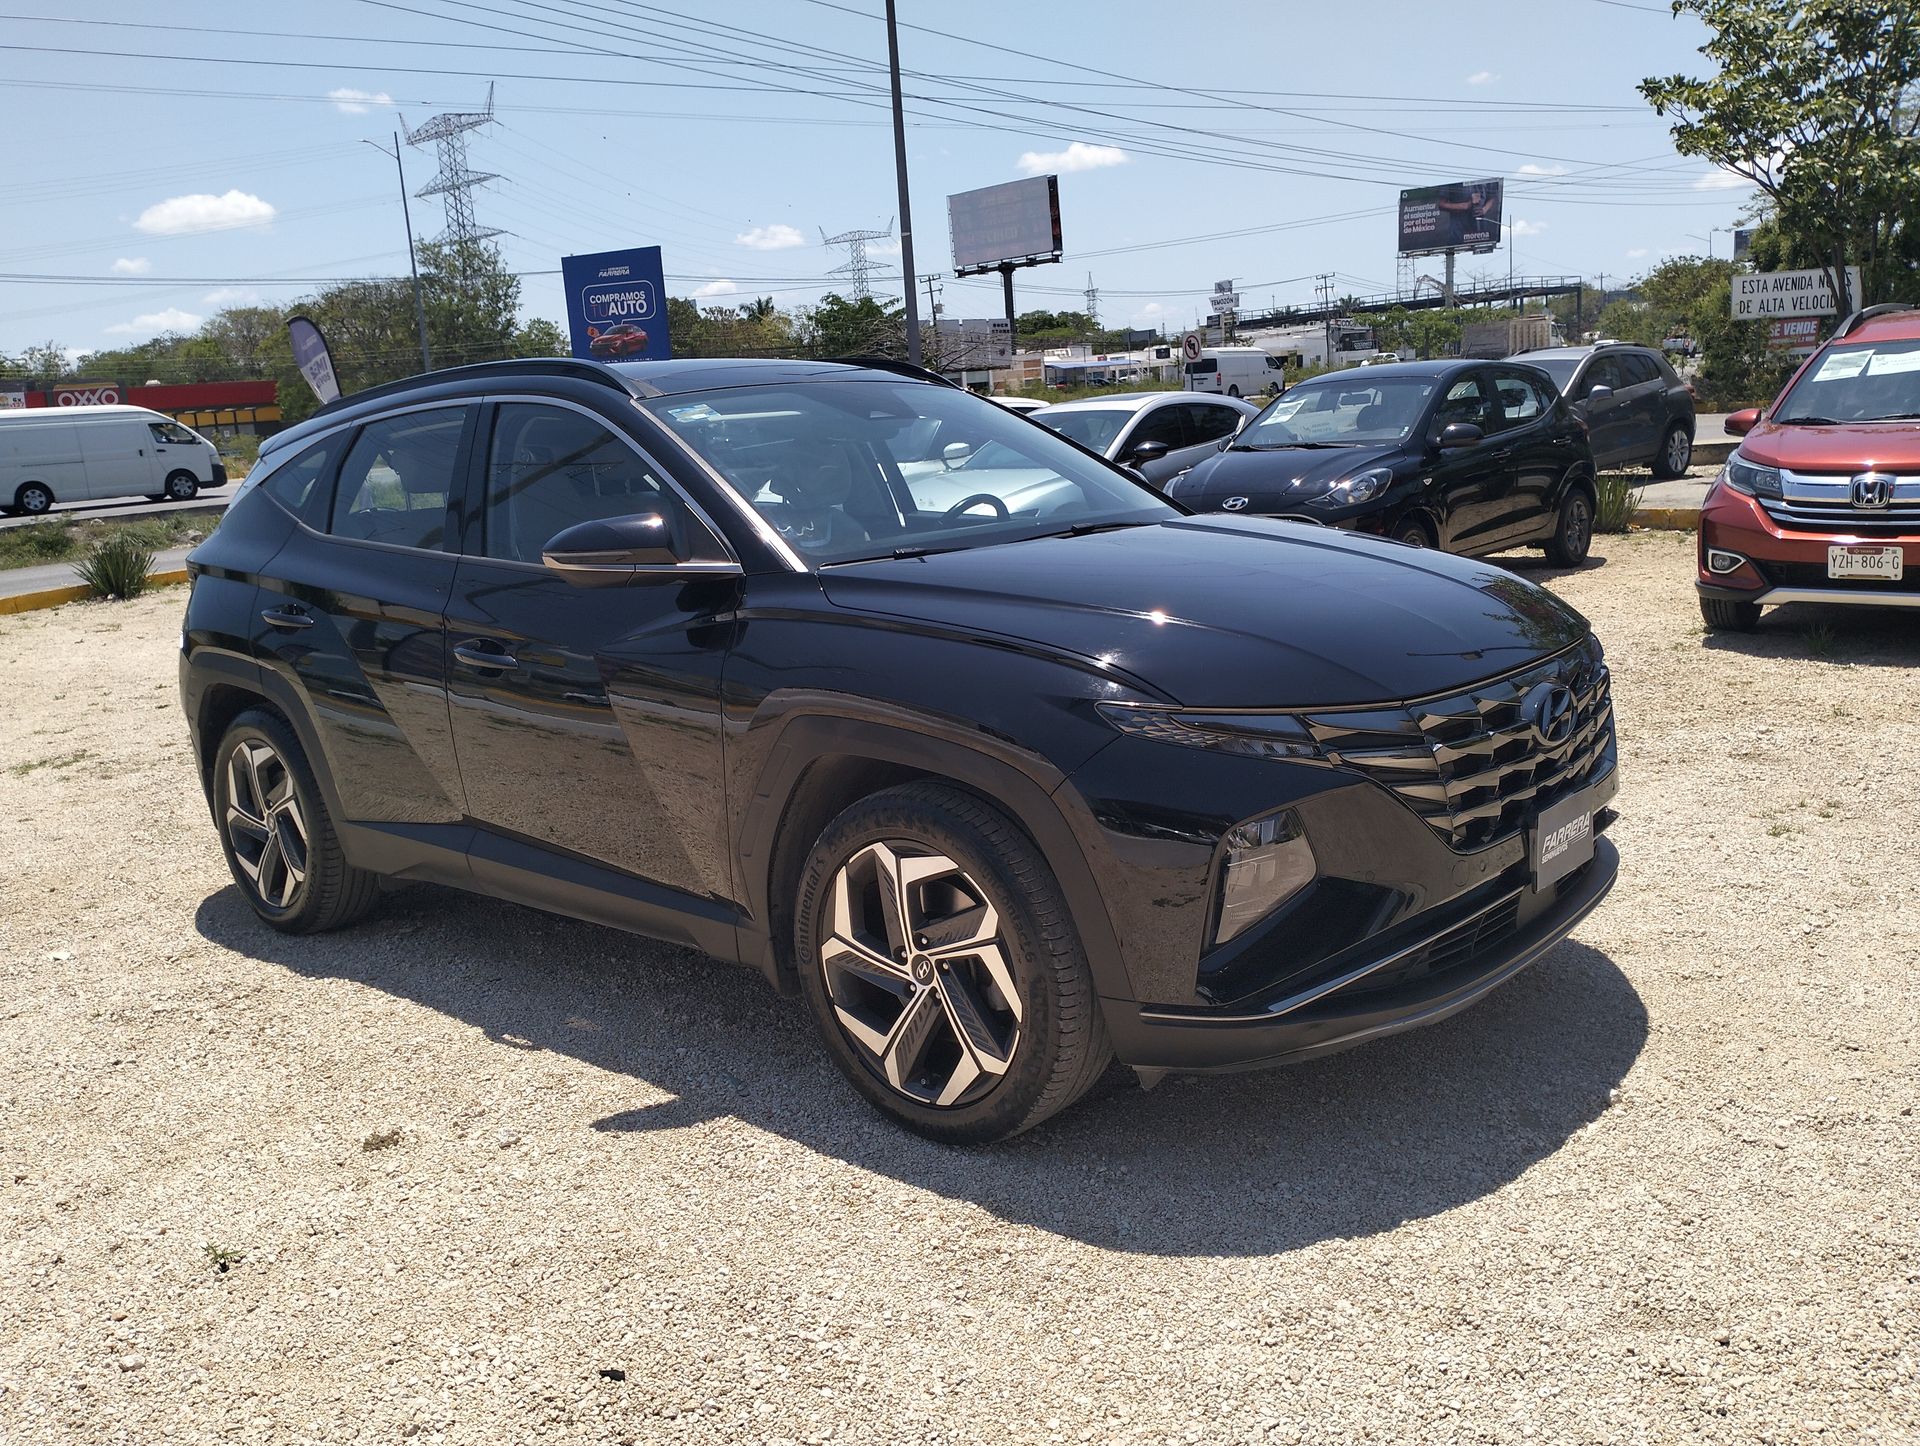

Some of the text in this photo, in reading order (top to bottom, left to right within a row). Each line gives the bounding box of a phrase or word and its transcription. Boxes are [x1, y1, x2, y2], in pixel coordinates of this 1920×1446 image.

[1403, 202, 1437, 213] Aumentar
[1412, 225, 1436, 233] México
[1463, 231, 1490, 240] morena
[1741, 279, 1769, 295] ESTA
[1772, 274, 1814, 293] AVENIDA
[589, 290, 646, 304] COMPRAMOS
[591, 299, 647, 318] TU AUTO
[1739, 299, 1752, 314] DE
[1758, 297, 1785, 313] ALTA
[1783, 320, 1818, 336] VENDE
[57, 387, 119, 407] OXXO
[1831, 554, 1899, 570] YZH-806-G
[1542, 811, 1591, 854] FARRERA
